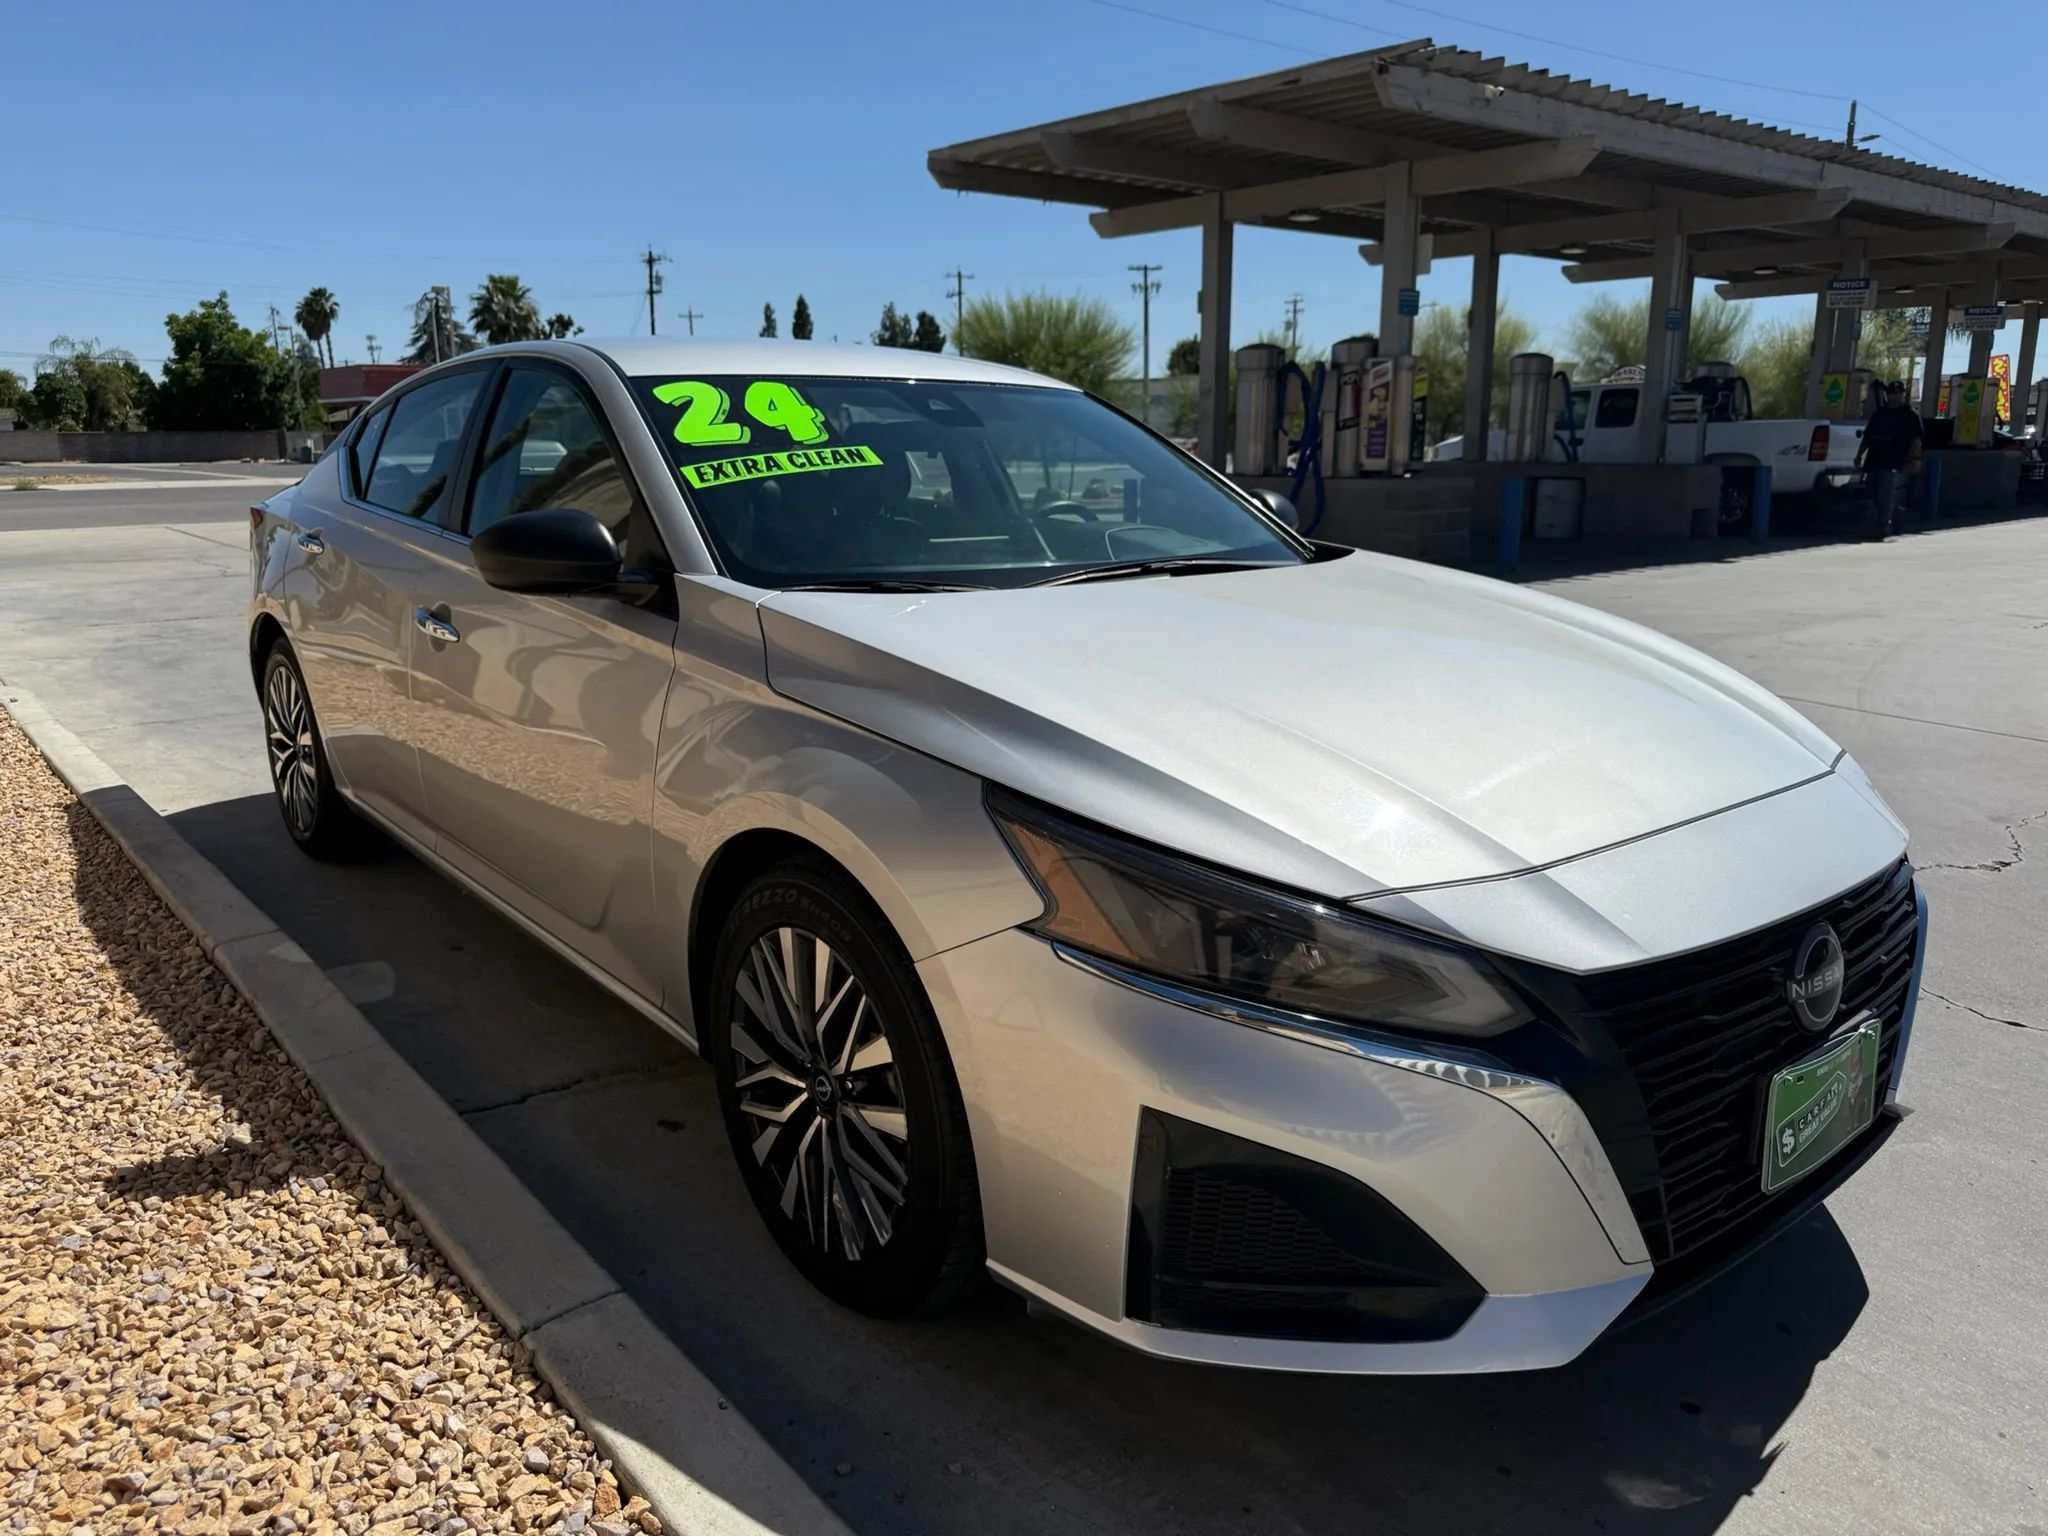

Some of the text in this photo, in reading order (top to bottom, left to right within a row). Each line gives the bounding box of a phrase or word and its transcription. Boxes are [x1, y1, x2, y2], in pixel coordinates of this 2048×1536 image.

[1832, 280, 1867, 289] NOTICE
[1968, 306, 1999, 315] NOTICE
[653, 381, 829, 446] 24
[694, 448, 868, 484] EXTRA CLEAN
[1791, 965, 1842, 999] NISSA
